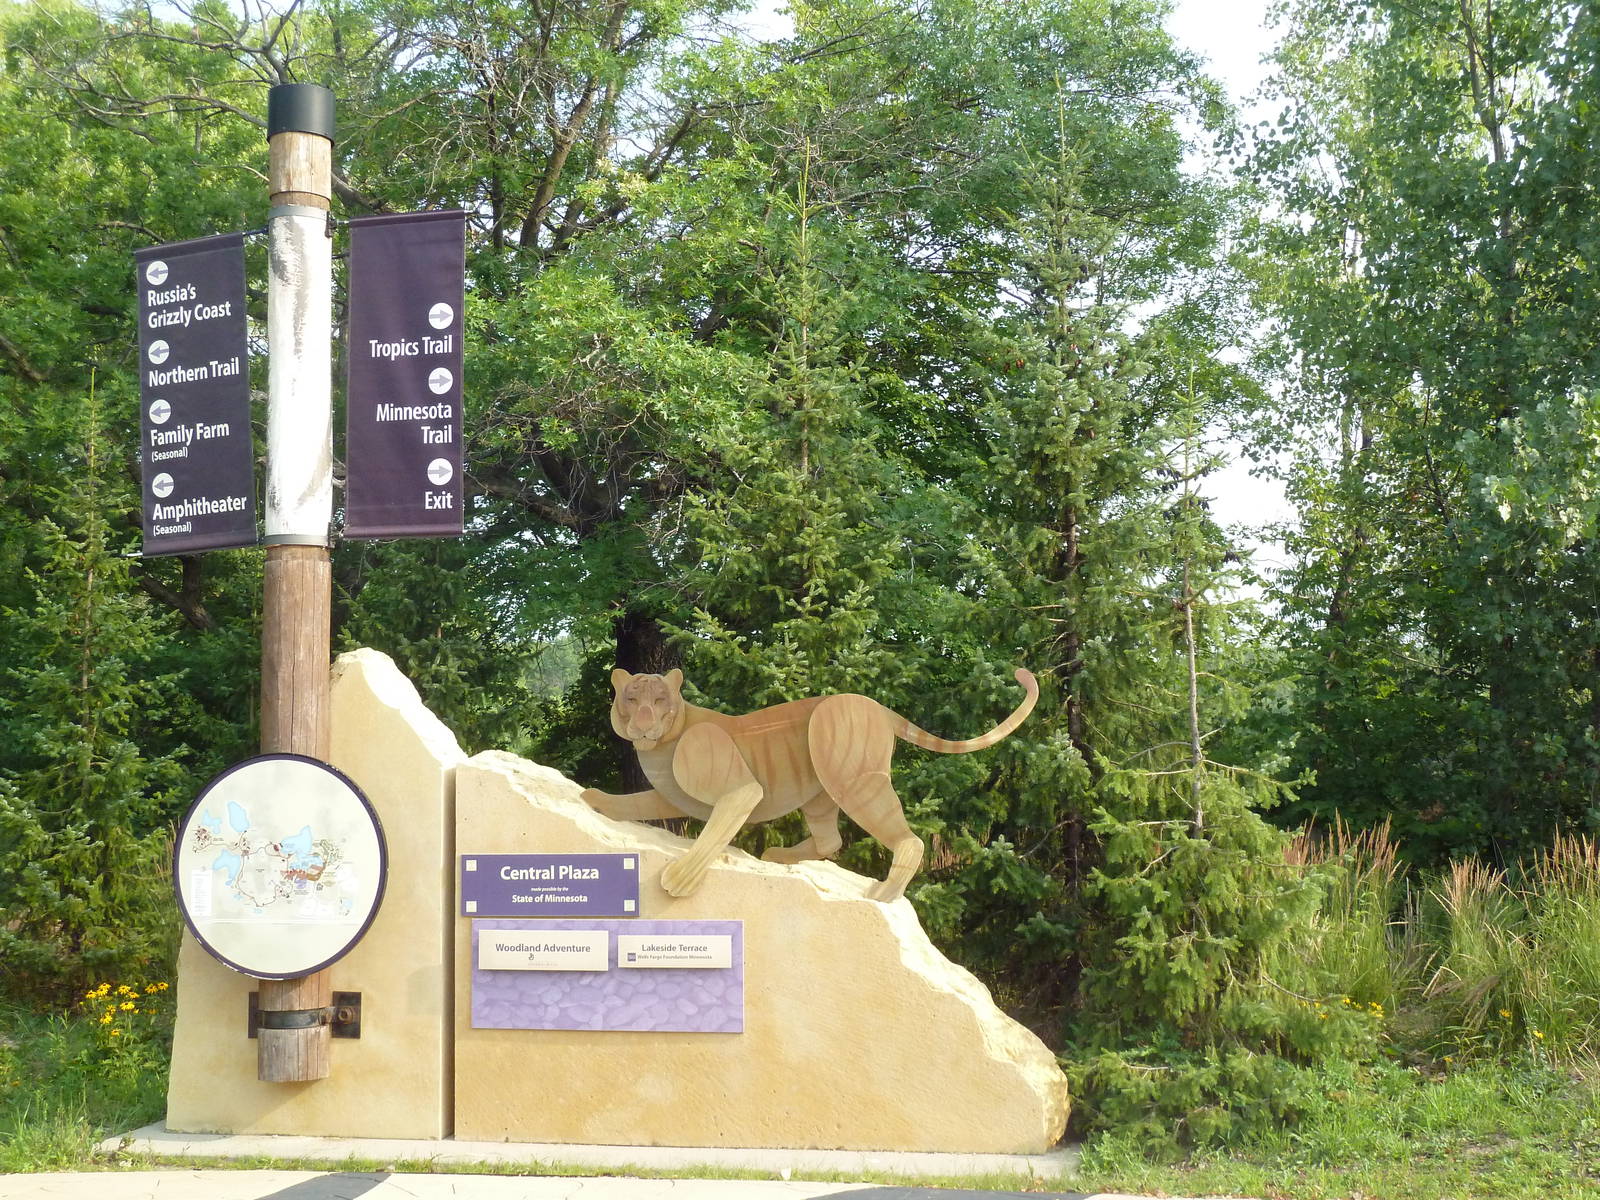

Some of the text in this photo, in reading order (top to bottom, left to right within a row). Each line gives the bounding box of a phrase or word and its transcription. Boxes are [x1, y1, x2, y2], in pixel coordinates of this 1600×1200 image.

[148, 283, 196, 306] Russia's
[148, 301, 231, 328] Grizzly Coast
[369, 335, 453, 361] Tropics Trail
[149, 356, 240, 387] Northern Trail
[376, 402, 453, 422] Minnesota
[151, 422, 230, 446] Family Farm
[421, 425, 453, 444] Trail
[151, 446, 188, 462] (Seasonal)
[152, 496, 247, 522] Amphitheater
[425, 491, 453, 510] Exit
[153, 521, 192, 536] (Seasonal)
[500, 864, 599, 880] Central Plaza
[512, 894, 588, 903] State of Minnesota
[495, 943, 591, 953] Woodland Adventure
[641, 944, 708, 952] Lakeside Terrace
